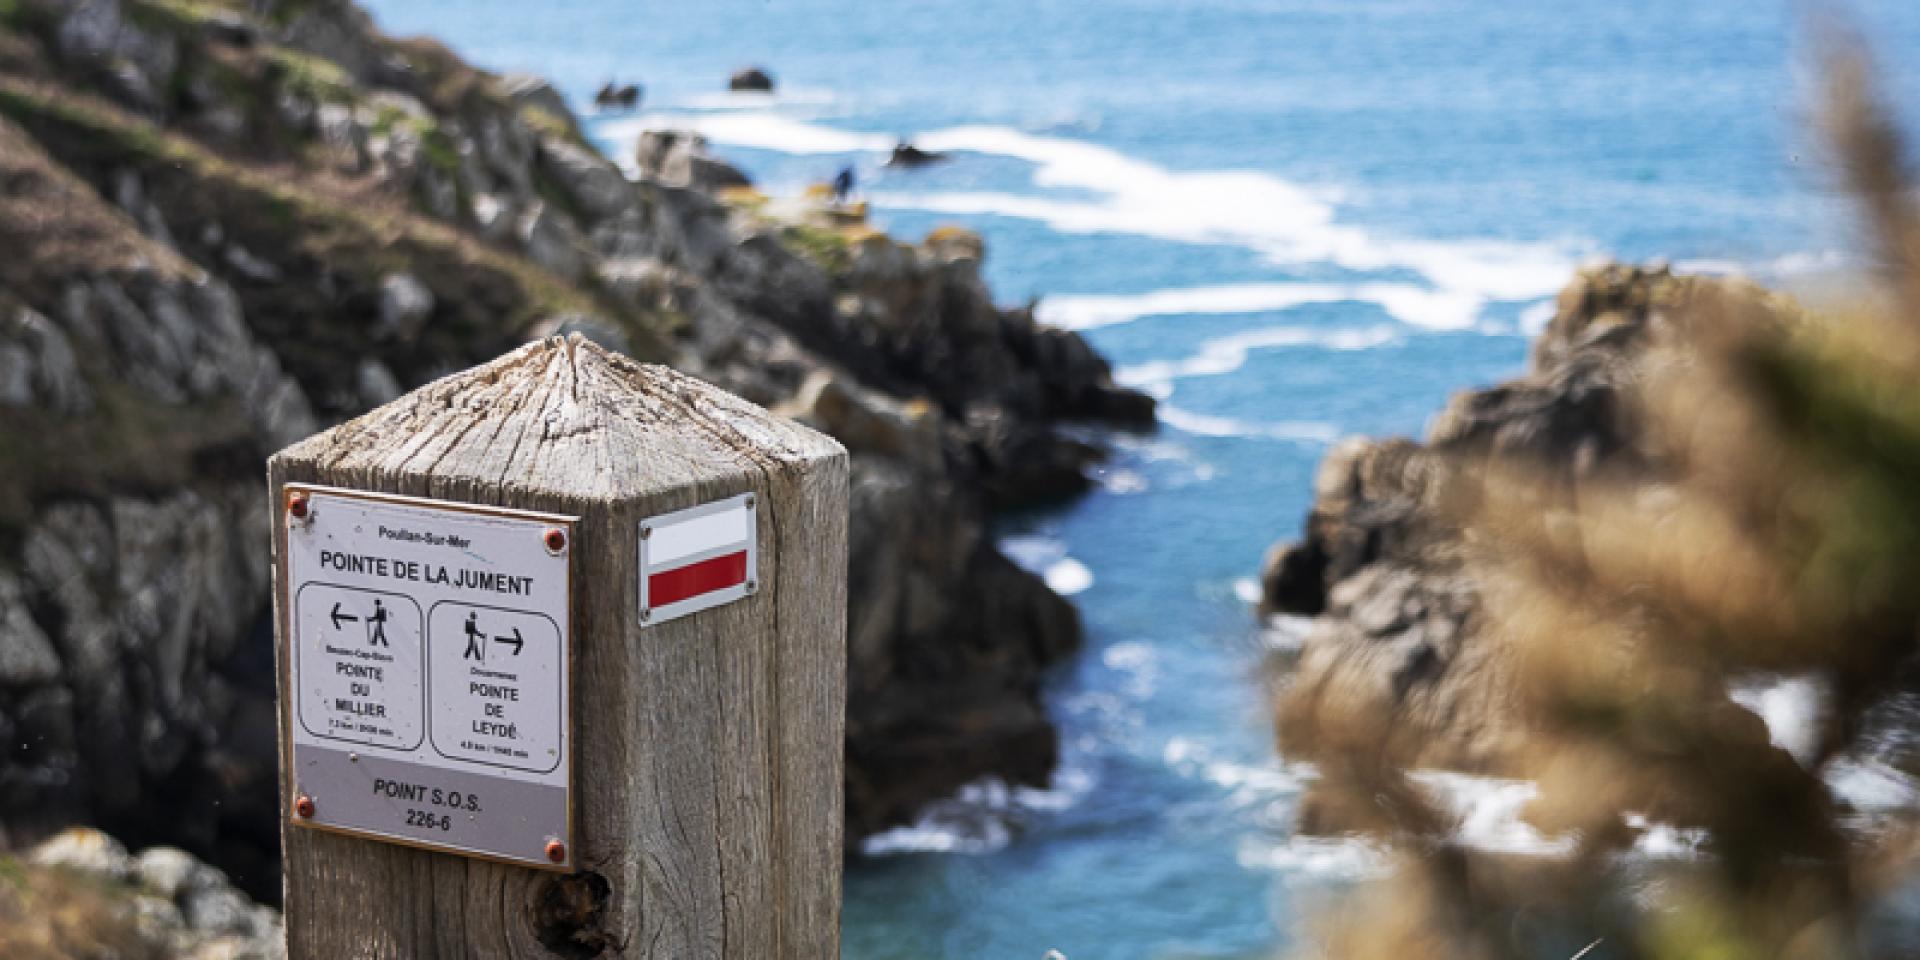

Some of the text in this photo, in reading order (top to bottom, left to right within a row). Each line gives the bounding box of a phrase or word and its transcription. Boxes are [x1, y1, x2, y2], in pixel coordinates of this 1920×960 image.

[320, 550, 533, 596] POINTE DE LA JUMENT
[336, 662, 384, 681] POINTE
[350, 682, 370, 697] DU
[470, 681, 519, 701] POINTE
[336, 698, 386, 718] MILLIER
[484, 703, 505, 718] DE
[472, 720, 517, 740] LEYDÉ
[374, 778, 482, 812] POINT S.O.S.
[406, 808, 451, 831] 226-6
